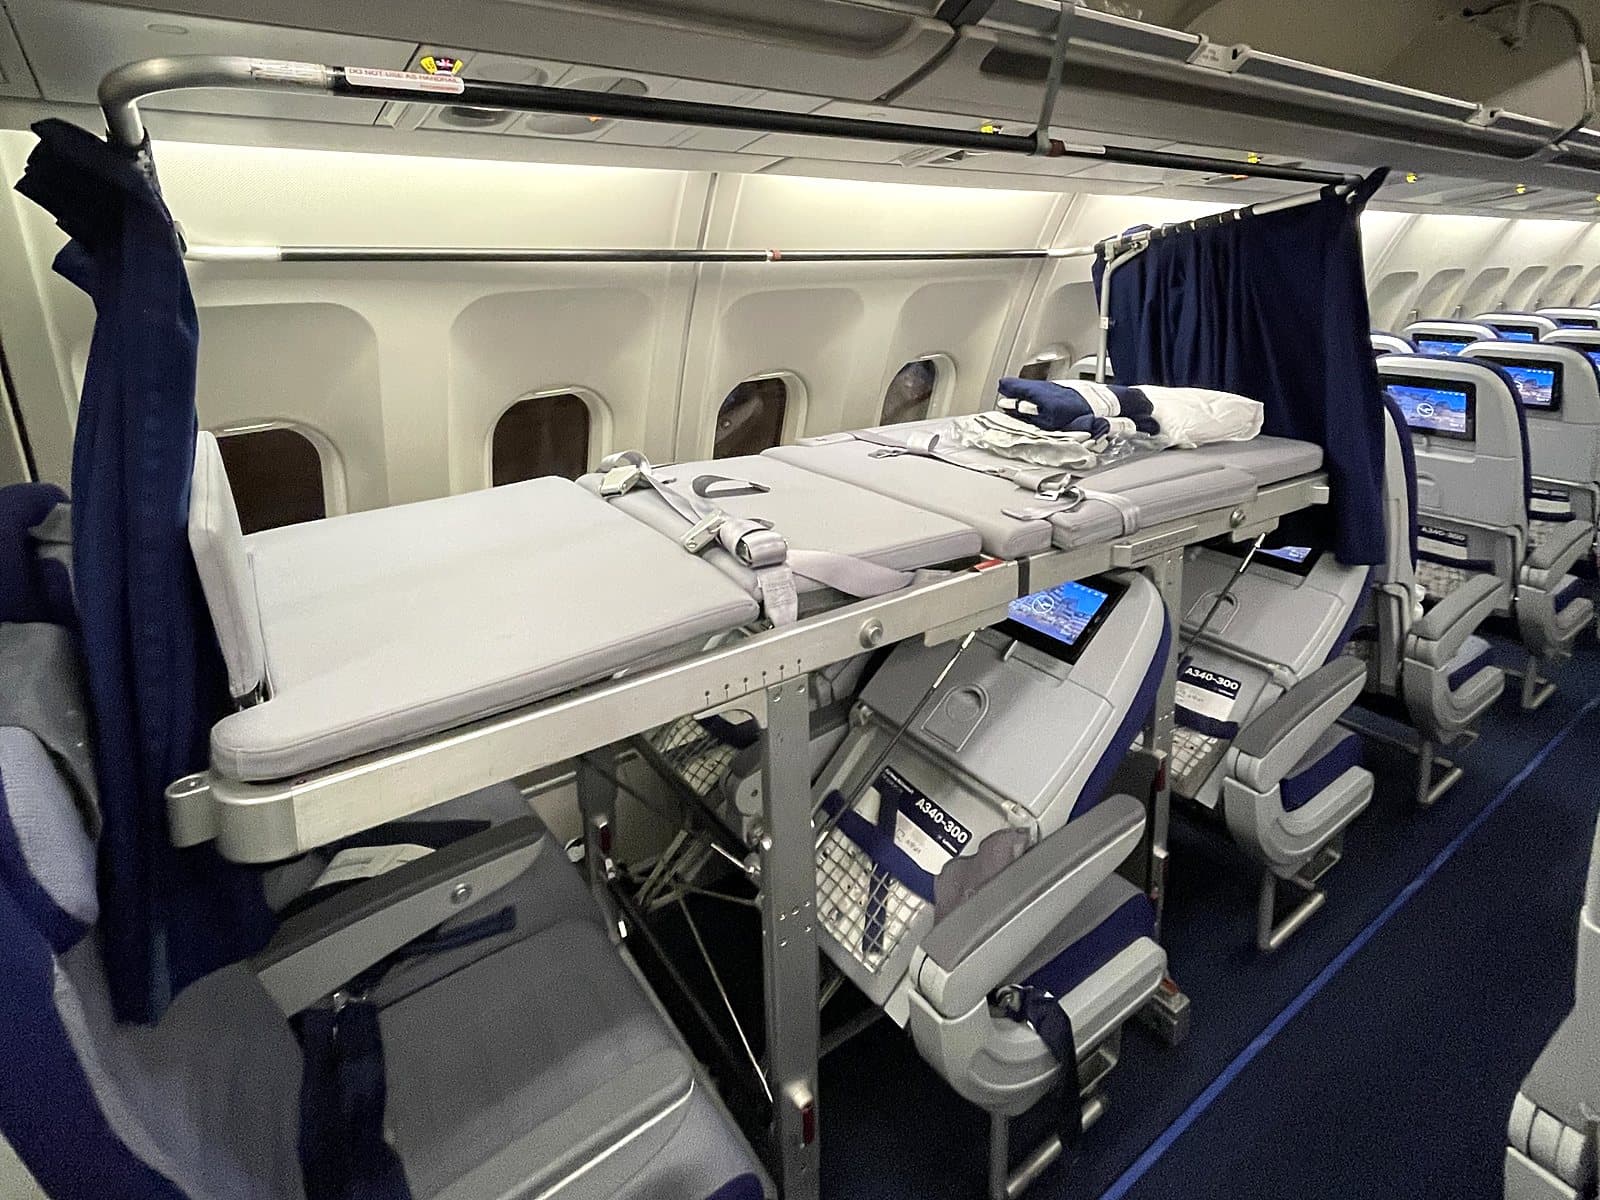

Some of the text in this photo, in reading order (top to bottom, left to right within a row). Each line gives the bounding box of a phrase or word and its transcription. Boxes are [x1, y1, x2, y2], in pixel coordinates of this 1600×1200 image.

[365, 69, 382, 77] NOT
[1185, 667, 1239, 690] A340-300
[915, 798, 968, 844] A340-300
